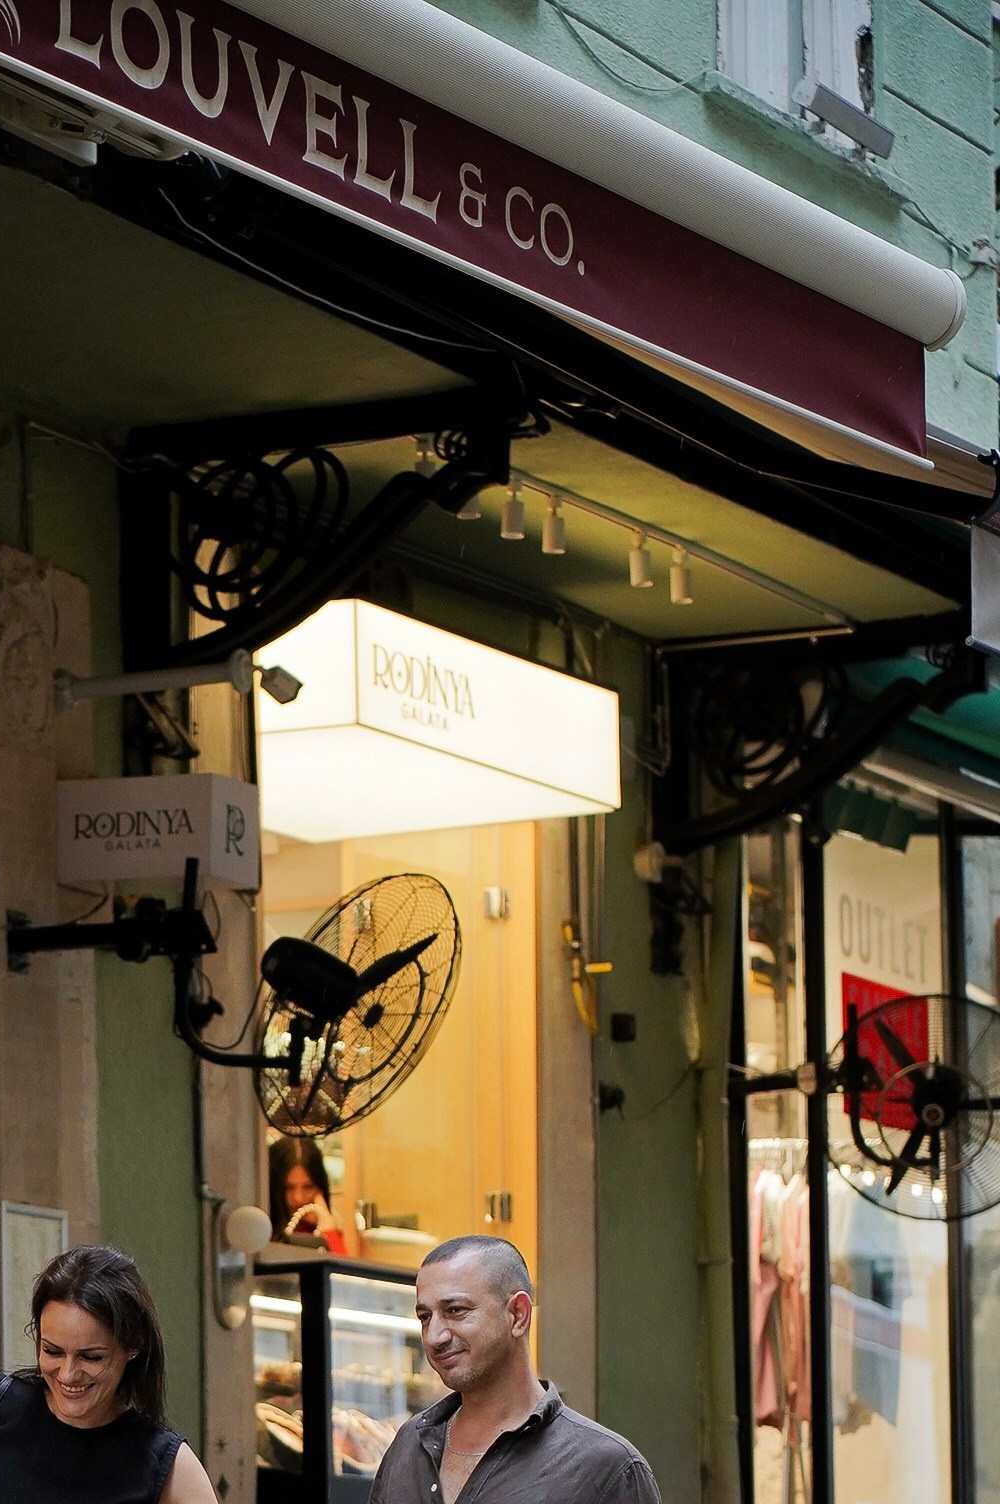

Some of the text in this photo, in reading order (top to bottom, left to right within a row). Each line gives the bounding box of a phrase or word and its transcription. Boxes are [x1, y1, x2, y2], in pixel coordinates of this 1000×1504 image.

[54, 0, 586, 276] LOUVELL & CO.
[839, 894, 928, 984] OUTLET
